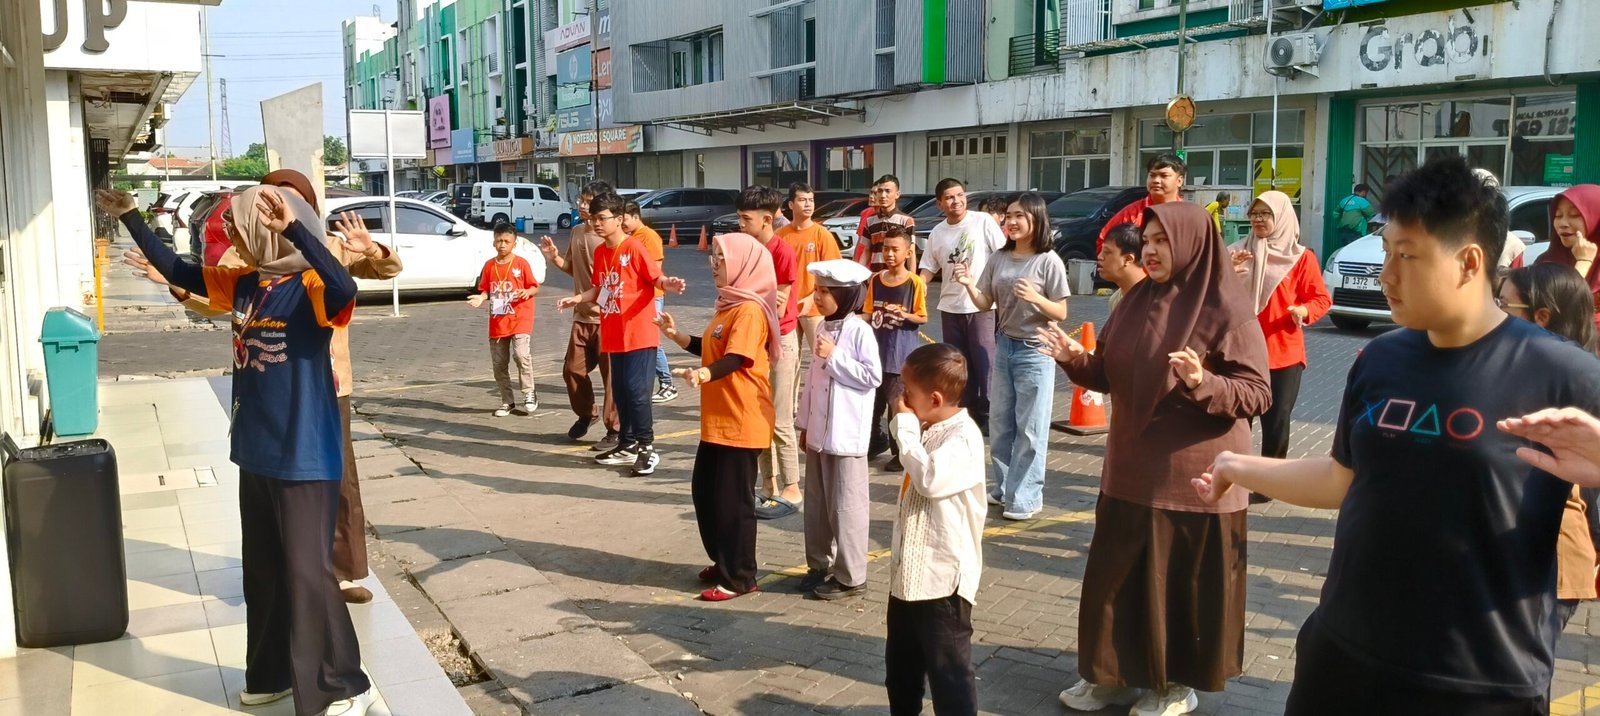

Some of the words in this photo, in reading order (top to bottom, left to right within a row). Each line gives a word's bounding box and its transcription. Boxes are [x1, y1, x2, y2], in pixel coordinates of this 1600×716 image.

[559, 21, 586, 40] ADVAN
[1359, 15, 1479, 72] Grab
[557, 111, 579, 129] ASUS
[602, 129, 627, 144] SQUARE
[1352, 276, 1369, 286] 1372
